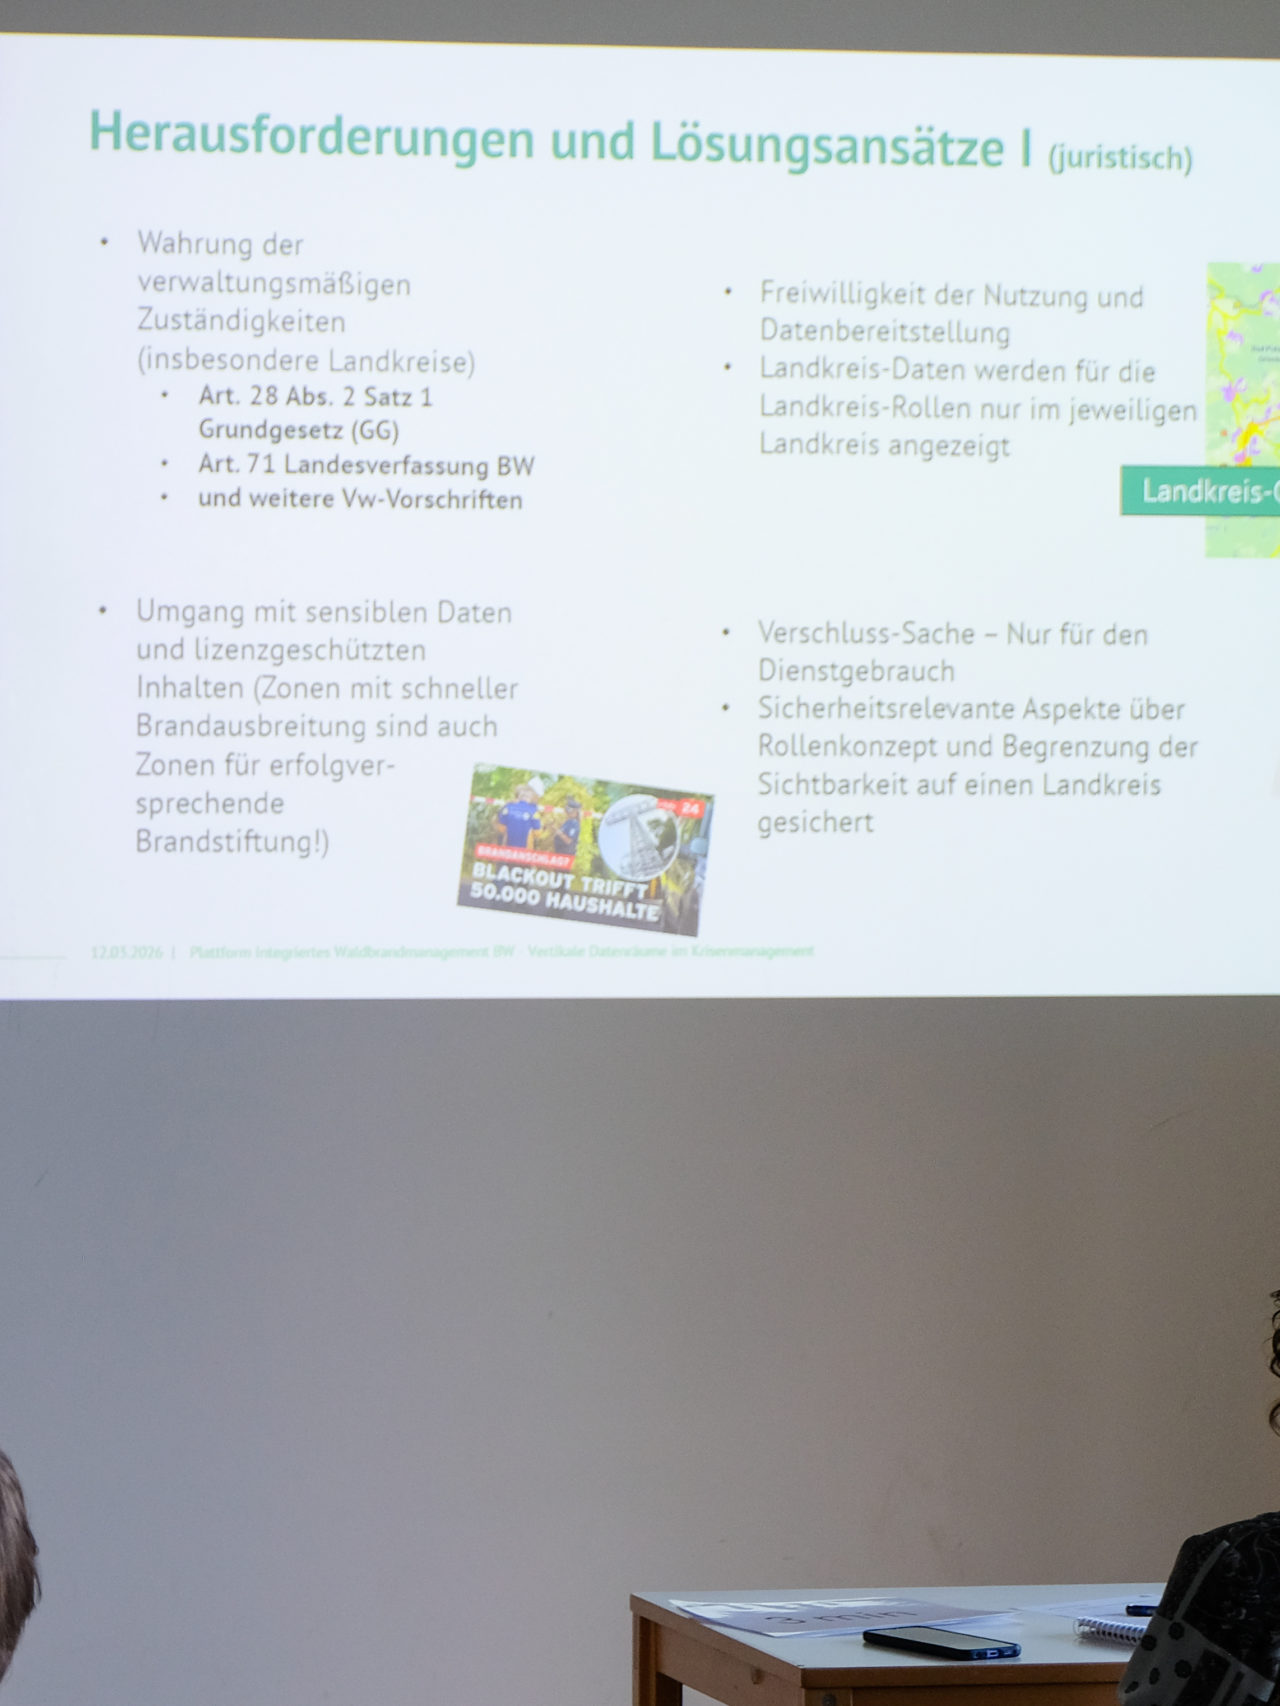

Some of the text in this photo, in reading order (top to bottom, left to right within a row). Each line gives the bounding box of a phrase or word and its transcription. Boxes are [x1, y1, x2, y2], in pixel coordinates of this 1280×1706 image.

[91, 109, 533, 169] Herausforderungen
[552, 120, 634, 160] und
[653, 120, 1004, 175] Lösungsansätze
[1049, 143, 1193, 177] (juristisch)
[138, 229, 304, 262] Wahrung der
[138, 269, 410, 302] verwaltungsmäßigen
[761, 279, 1144, 314] Freiwilligkeit der Nutzung und
[138, 305, 345, 338] Zuständigkeiten
[761, 316, 1010, 350] Datenbereitstellung
[138, 345, 475, 380] (insbesondere Landkreise)
[761, 355, 1156, 383] Landkreis-Daten werden für die
[199, 384, 433, 408] Art. 28 Abs. 2 Satz 1
[760, 392, 1196, 427] Landkreis-Rollen nur im jeweiligen
[199, 418, 399, 445] Grundgesetz (GG)
[760, 430, 1010, 463] Landkreis angezeigt
[199, 452, 535, 481] Art. 71 Landesverfassung BW
[199, 486, 522, 510] und weitere Vw-Vorschriften
[138, 598, 512, 629] Umgang mit sensiblen Daten
[758, 620, 975, 645] Verschluss-Sache
[1008, 622, 1052, 646] Nur
[1060, 621, 1095, 645] für
[1103, 623, 1148, 646] den
[137, 637, 425, 667] und lizenzgeschützten
[759, 657, 954, 688] Dienstgebrauch
[138, 674, 519, 705] Inhalten (Zonen mit schneller
[759, 695, 1186, 725] Sicherheitsrelevante Aspekte über
[137, 712, 497, 743] Brandausbreitung sind auch
[759, 732, 1199, 764] Rollenkonzept und Begrenzung der
[136, 751, 395, 783] Zonen für erfolgver-
[758, 771, 1162, 796] Sichtbarkeit auf einen Landkreis
[136, 791, 284, 820] sprechende
[681, 802, 699, 814] 24
[758, 809, 874, 839] gesichert
[137, 828, 329, 859] Brandstiftung!)
[472, 862, 649, 899] BLACKOUT TRIFFT
[470, 883, 661, 922] 50.000 HAUSHALTE
[765, 1608, 918, 1625] 3 min
